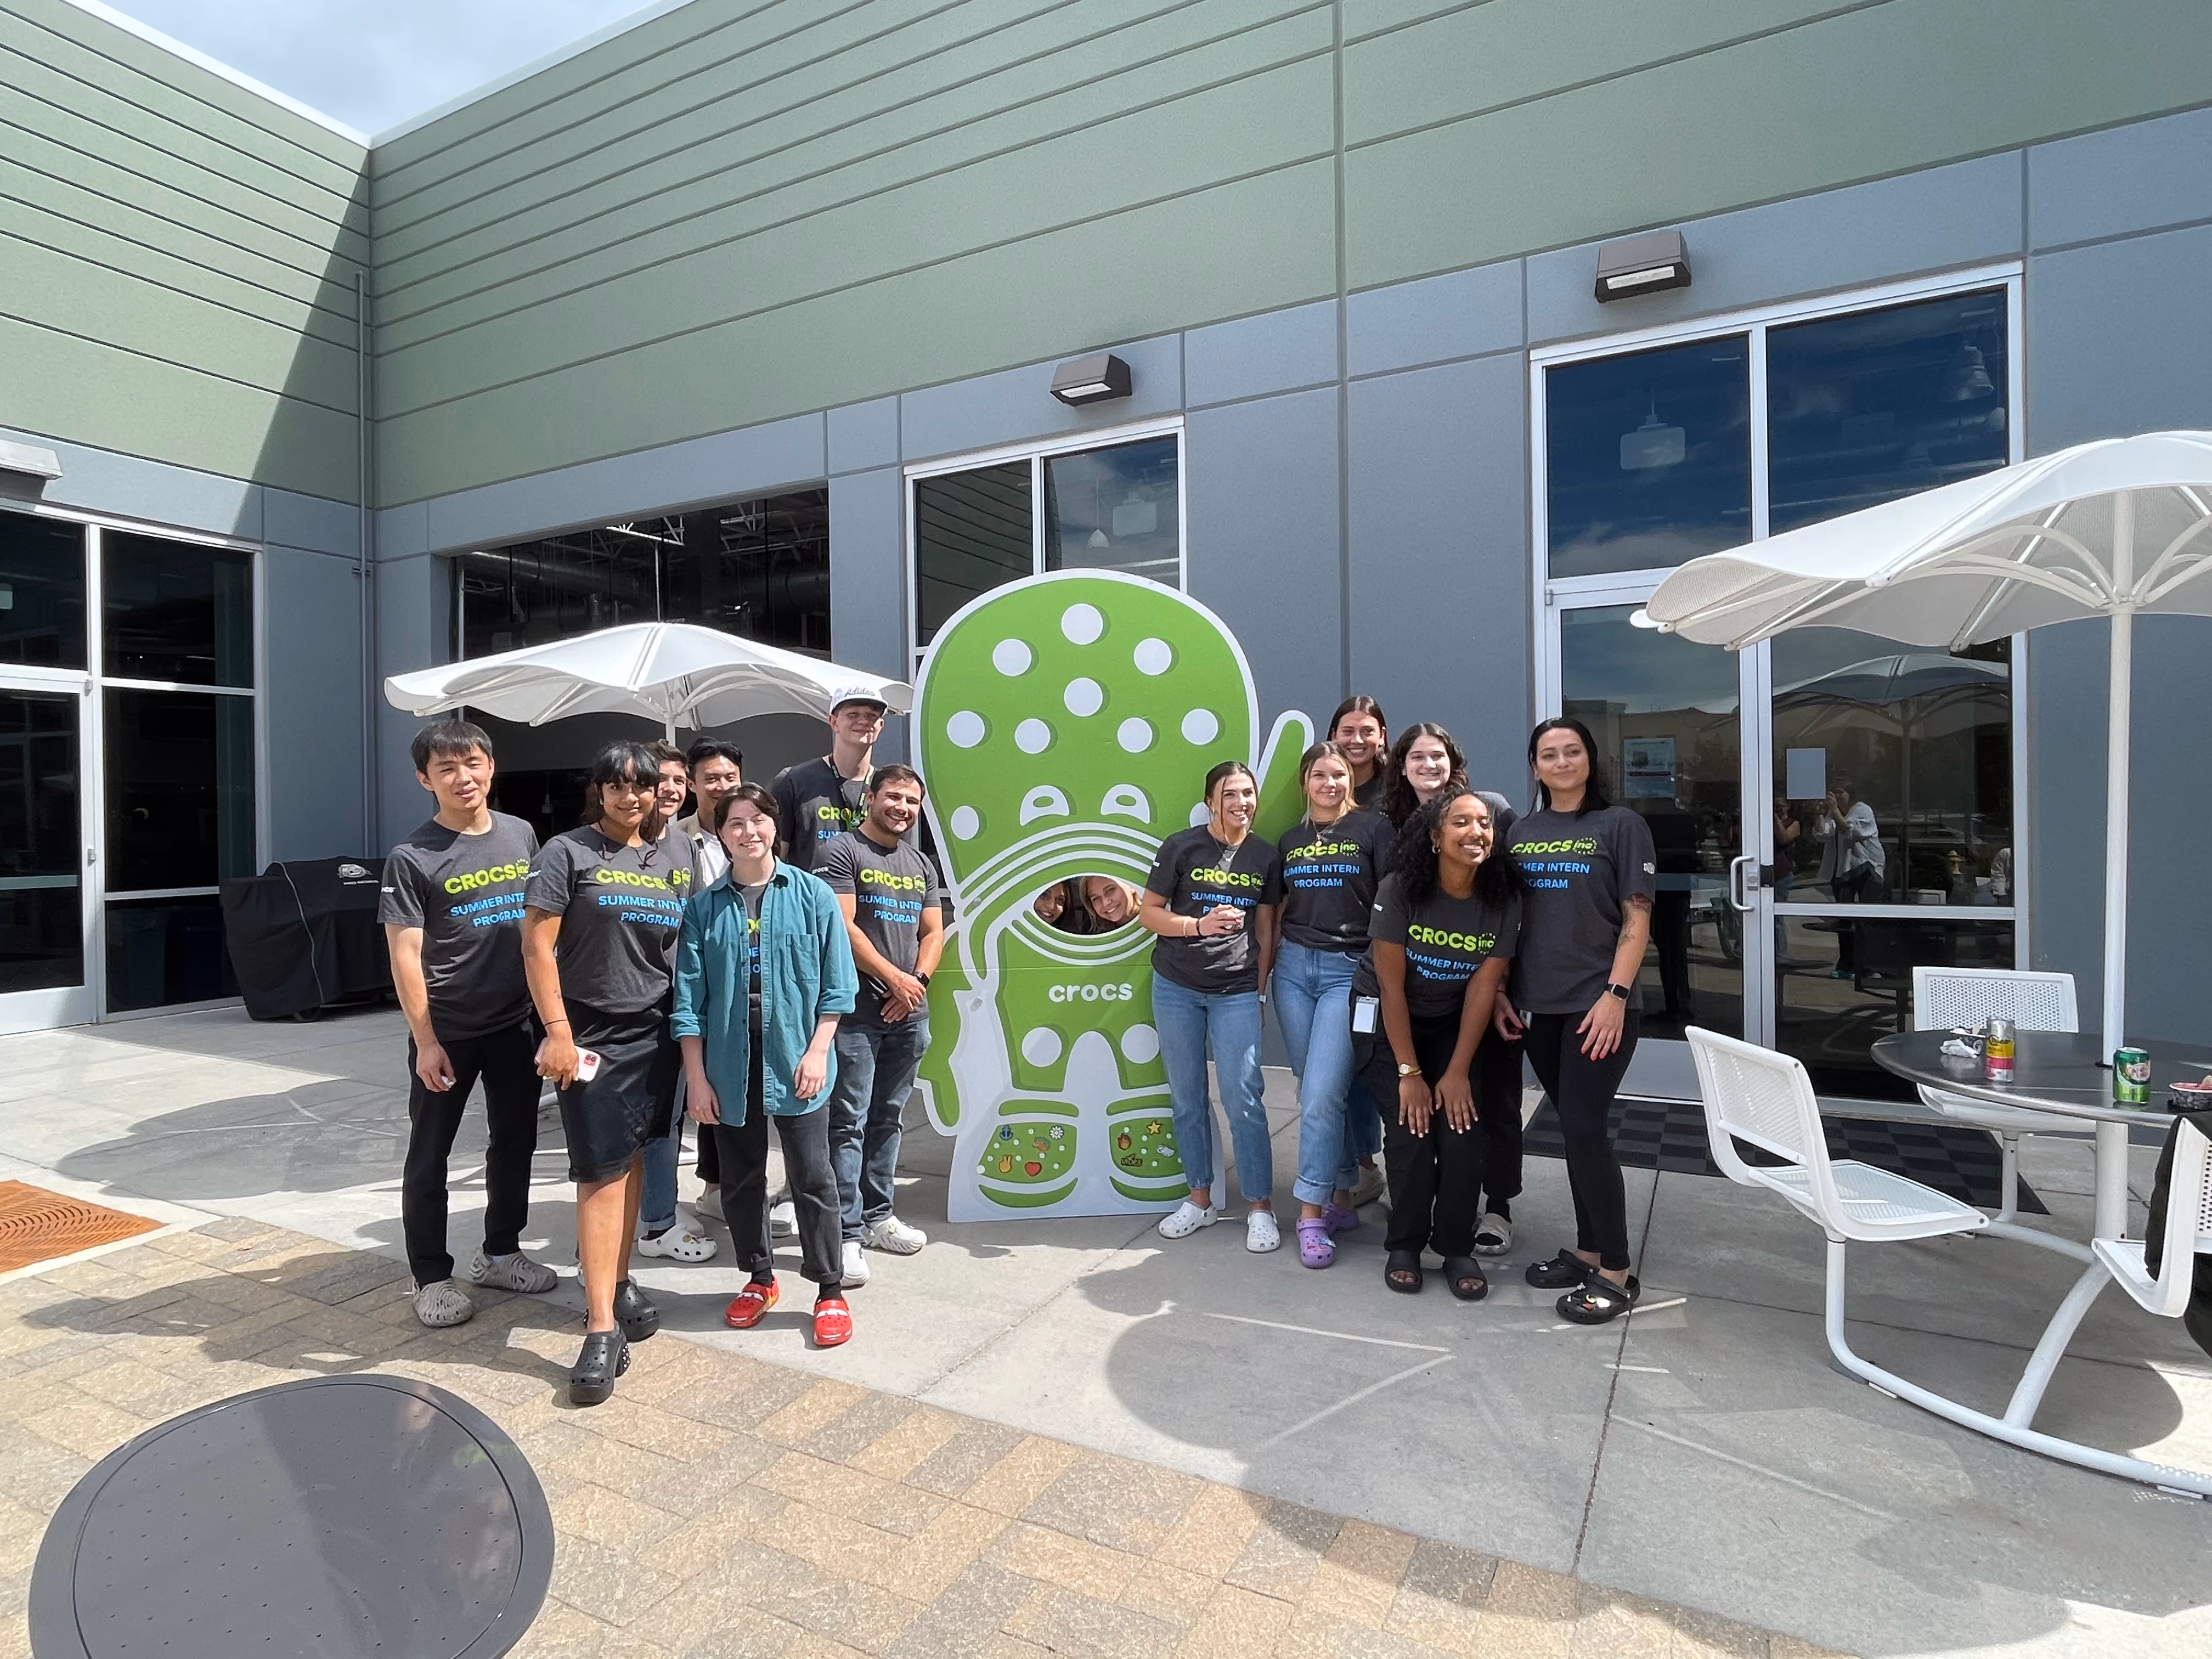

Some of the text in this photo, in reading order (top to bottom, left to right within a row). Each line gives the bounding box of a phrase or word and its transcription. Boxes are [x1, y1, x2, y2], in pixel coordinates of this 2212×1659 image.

[1286, 843, 1338, 861] CROCS
[1510, 839, 1573, 854] CROCS
[1322, 865, 1359, 874] INTERN
[1547, 862, 1589, 873] INTERN
[444, 864, 517, 894] CROCS
[596, 869, 667, 890] CROCS
[860, 868, 913, 890] CROCS
[1190, 868, 1251, 887] CROCS
[1294, 878, 1342, 888] PROGRAM
[1527, 879, 1568, 888] OGRAM
[450, 892, 524, 916] SUMMER INTE
[599, 895, 655, 908] SUMMER
[858, 894, 898, 909] SUMMER
[1191, 892, 1232, 904] SUMMER
[473, 909, 526, 927] PROGRAM
[621, 912, 679, 928] PROGRAM
[1408, 925, 1477, 951] CROCS
[1417, 966, 1470, 980] PROGRAM
[1048, 983, 1133, 1003] crocs
